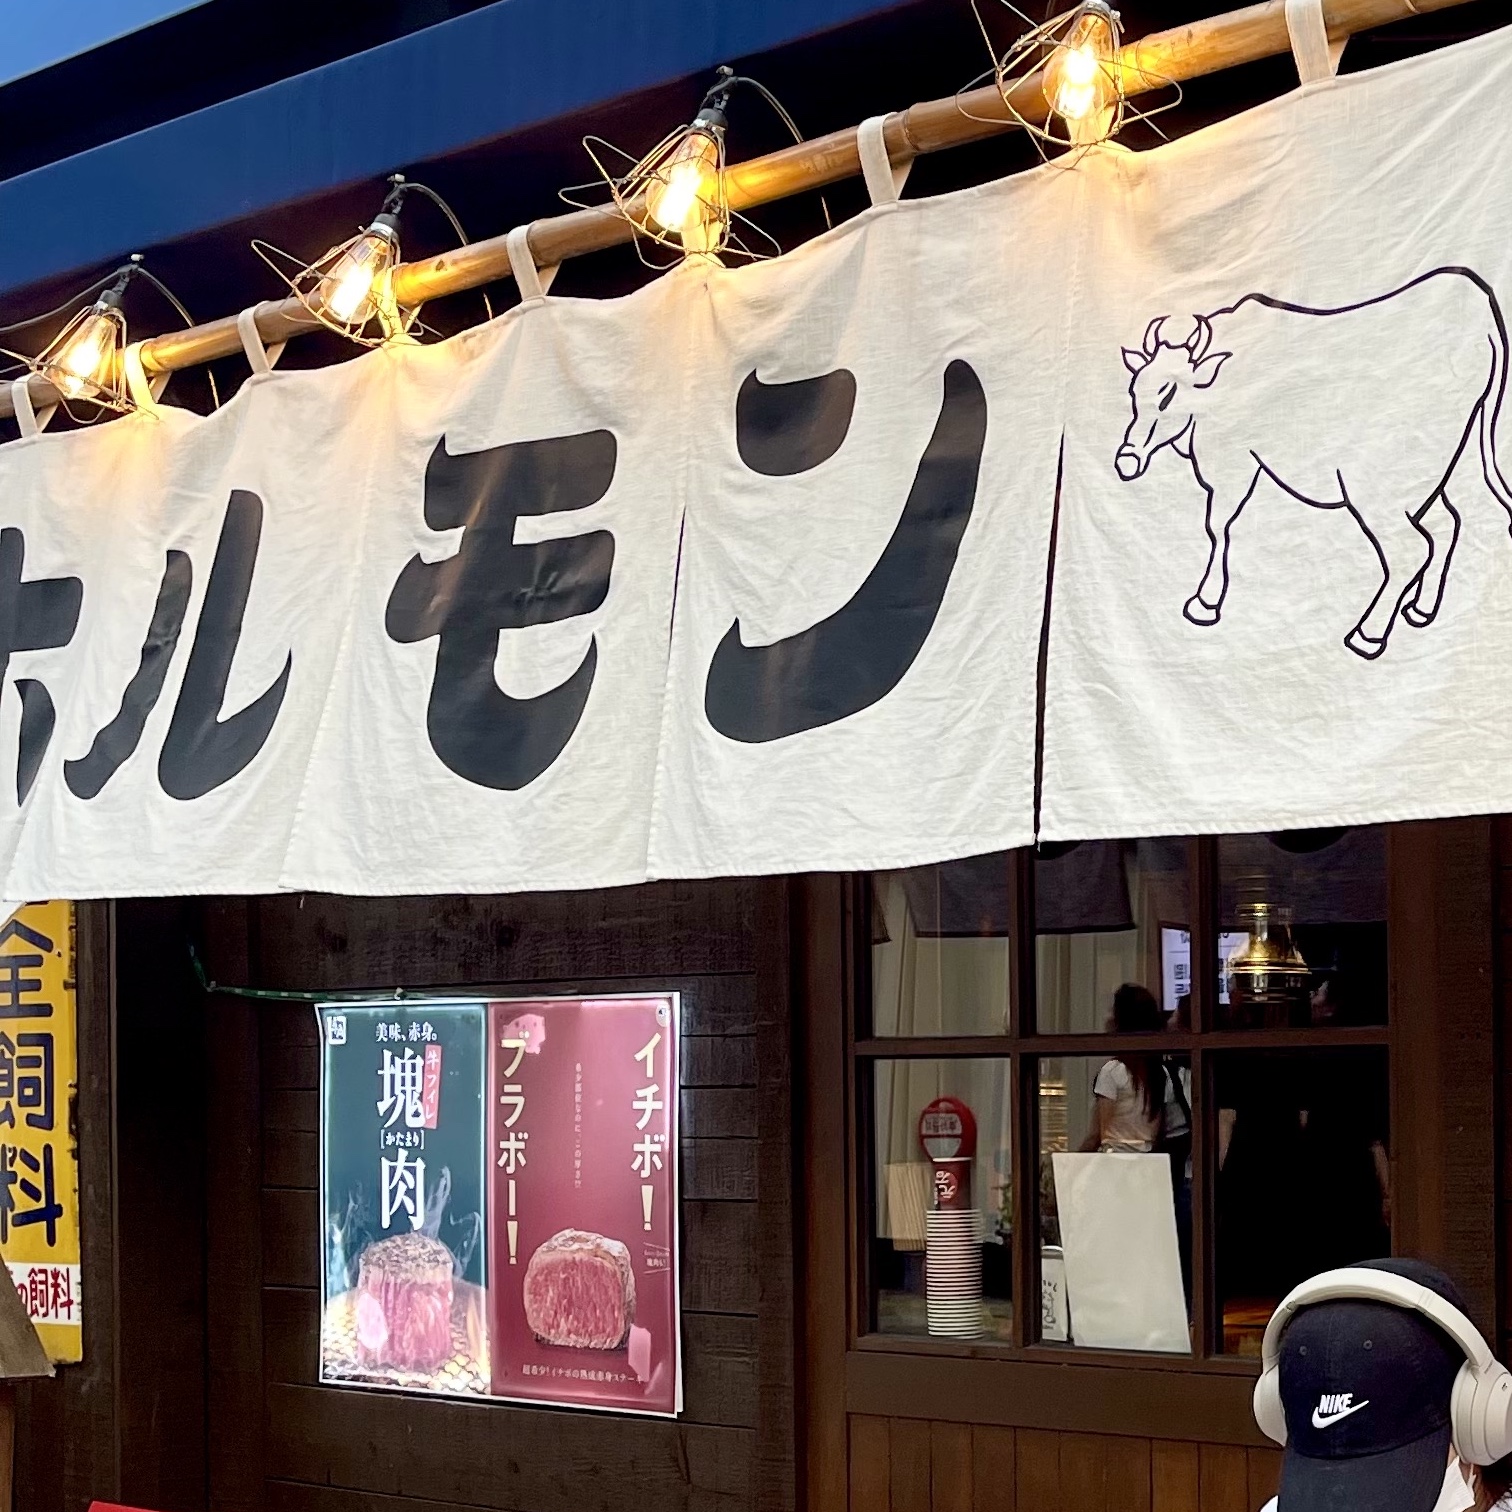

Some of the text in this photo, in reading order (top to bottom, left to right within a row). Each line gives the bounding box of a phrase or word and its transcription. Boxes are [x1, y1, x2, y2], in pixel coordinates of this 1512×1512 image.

[0, 359, 987, 807] ホルモン
[376, 1022, 437, 1042] 美味、赤身。
[1319, 1393, 1353, 1413] NIKE
